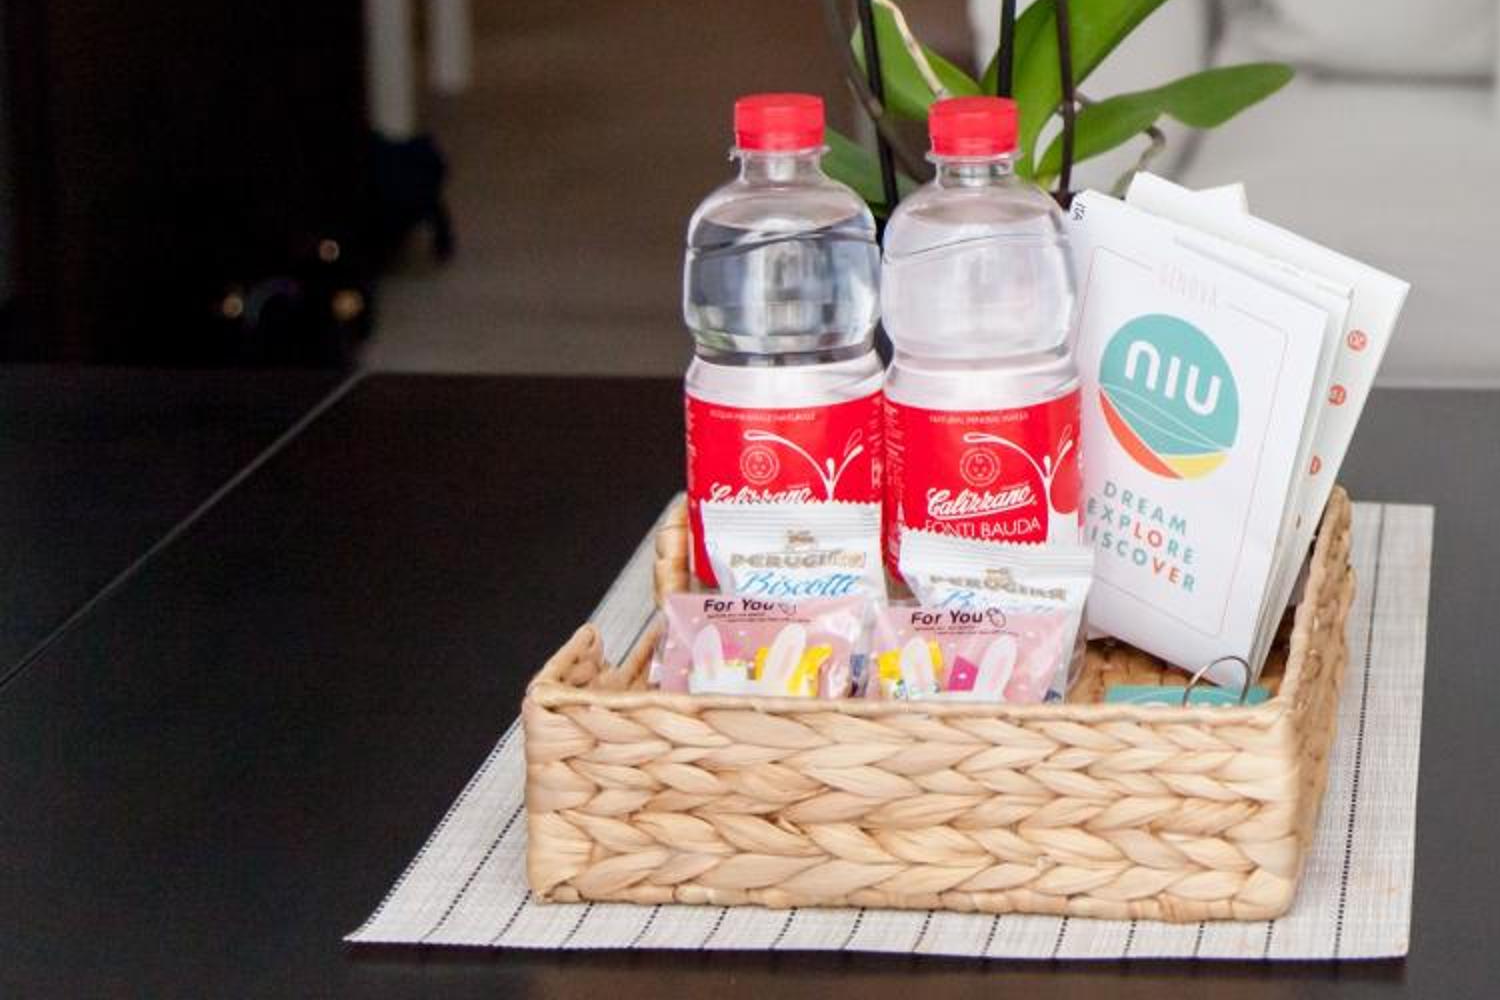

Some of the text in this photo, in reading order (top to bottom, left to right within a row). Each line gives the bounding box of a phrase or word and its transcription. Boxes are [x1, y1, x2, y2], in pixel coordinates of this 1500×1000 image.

[980, 515, 1041, 538] BAUDA
[1103, 480, 1187, 535] DREAM
[1087, 497, 1195, 565] EXPLORE
[1085, 524, 1195, 592] ISCOVER
[703, 600, 775, 613] For You
[911, 610, 983, 625] For You
